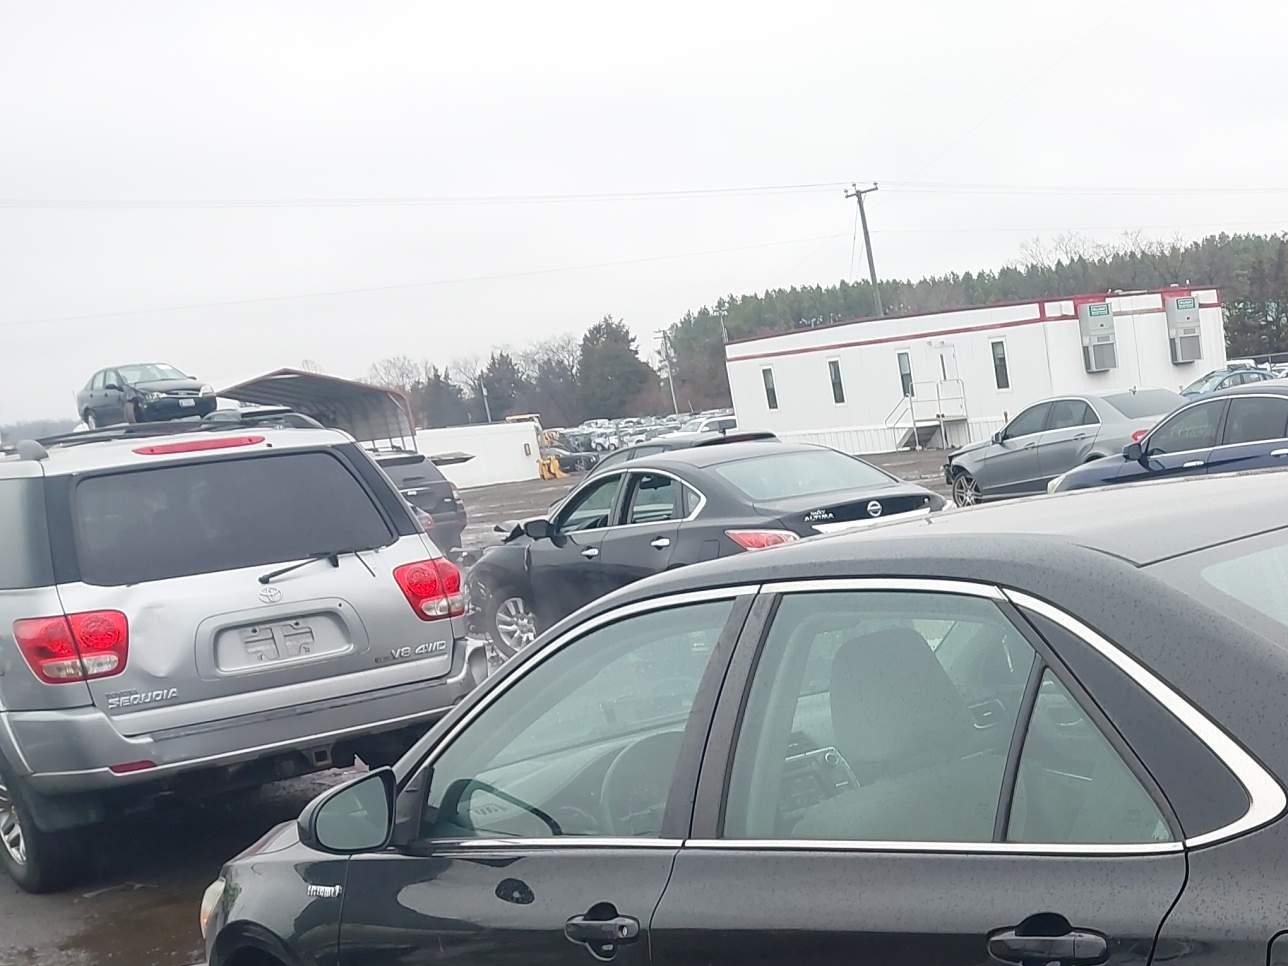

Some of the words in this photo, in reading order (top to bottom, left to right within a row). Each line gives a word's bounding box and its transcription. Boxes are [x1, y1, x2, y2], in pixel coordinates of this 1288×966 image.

[804, 511, 835, 523] ALTIMA
[391, 646, 411, 659] V8
[415, 640, 447, 655] 4WD
[108, 687, 177, 709] SEQUOIA
